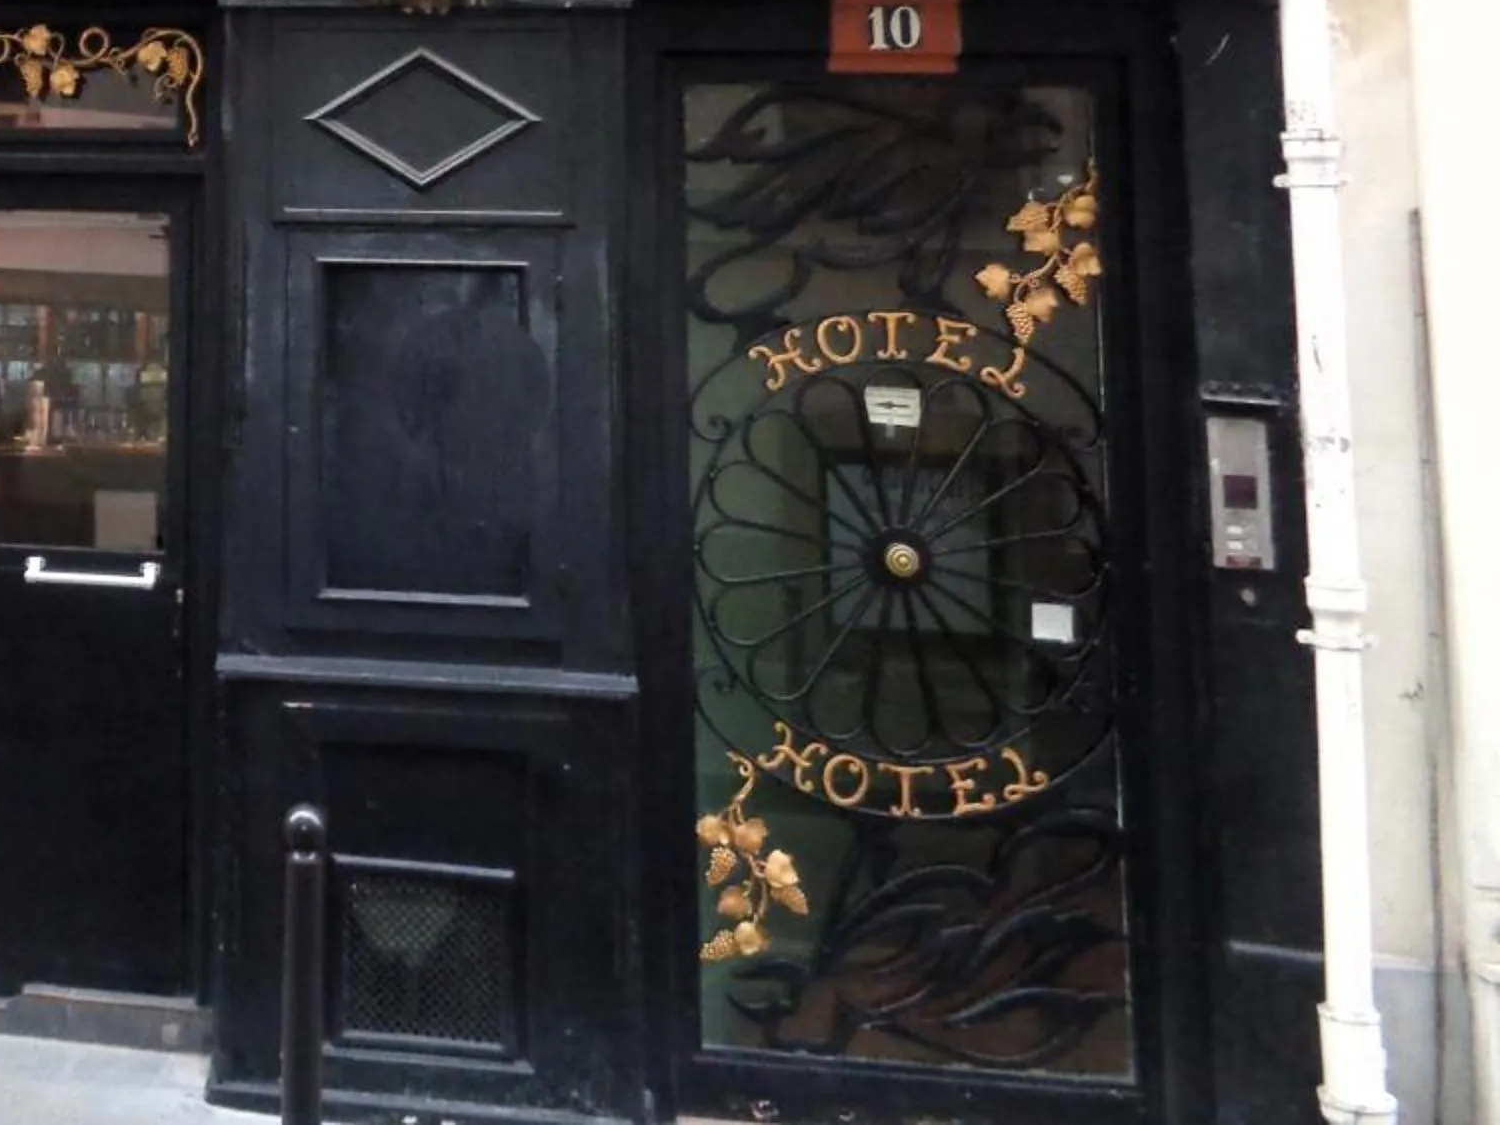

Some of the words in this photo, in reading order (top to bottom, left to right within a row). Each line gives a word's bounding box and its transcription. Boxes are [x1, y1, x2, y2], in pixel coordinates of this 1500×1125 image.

[867, 5, 921, 50] 10
[747, 311, 1026, 399] HOTEL
[756, 720, 1050, 817] HOTEL
